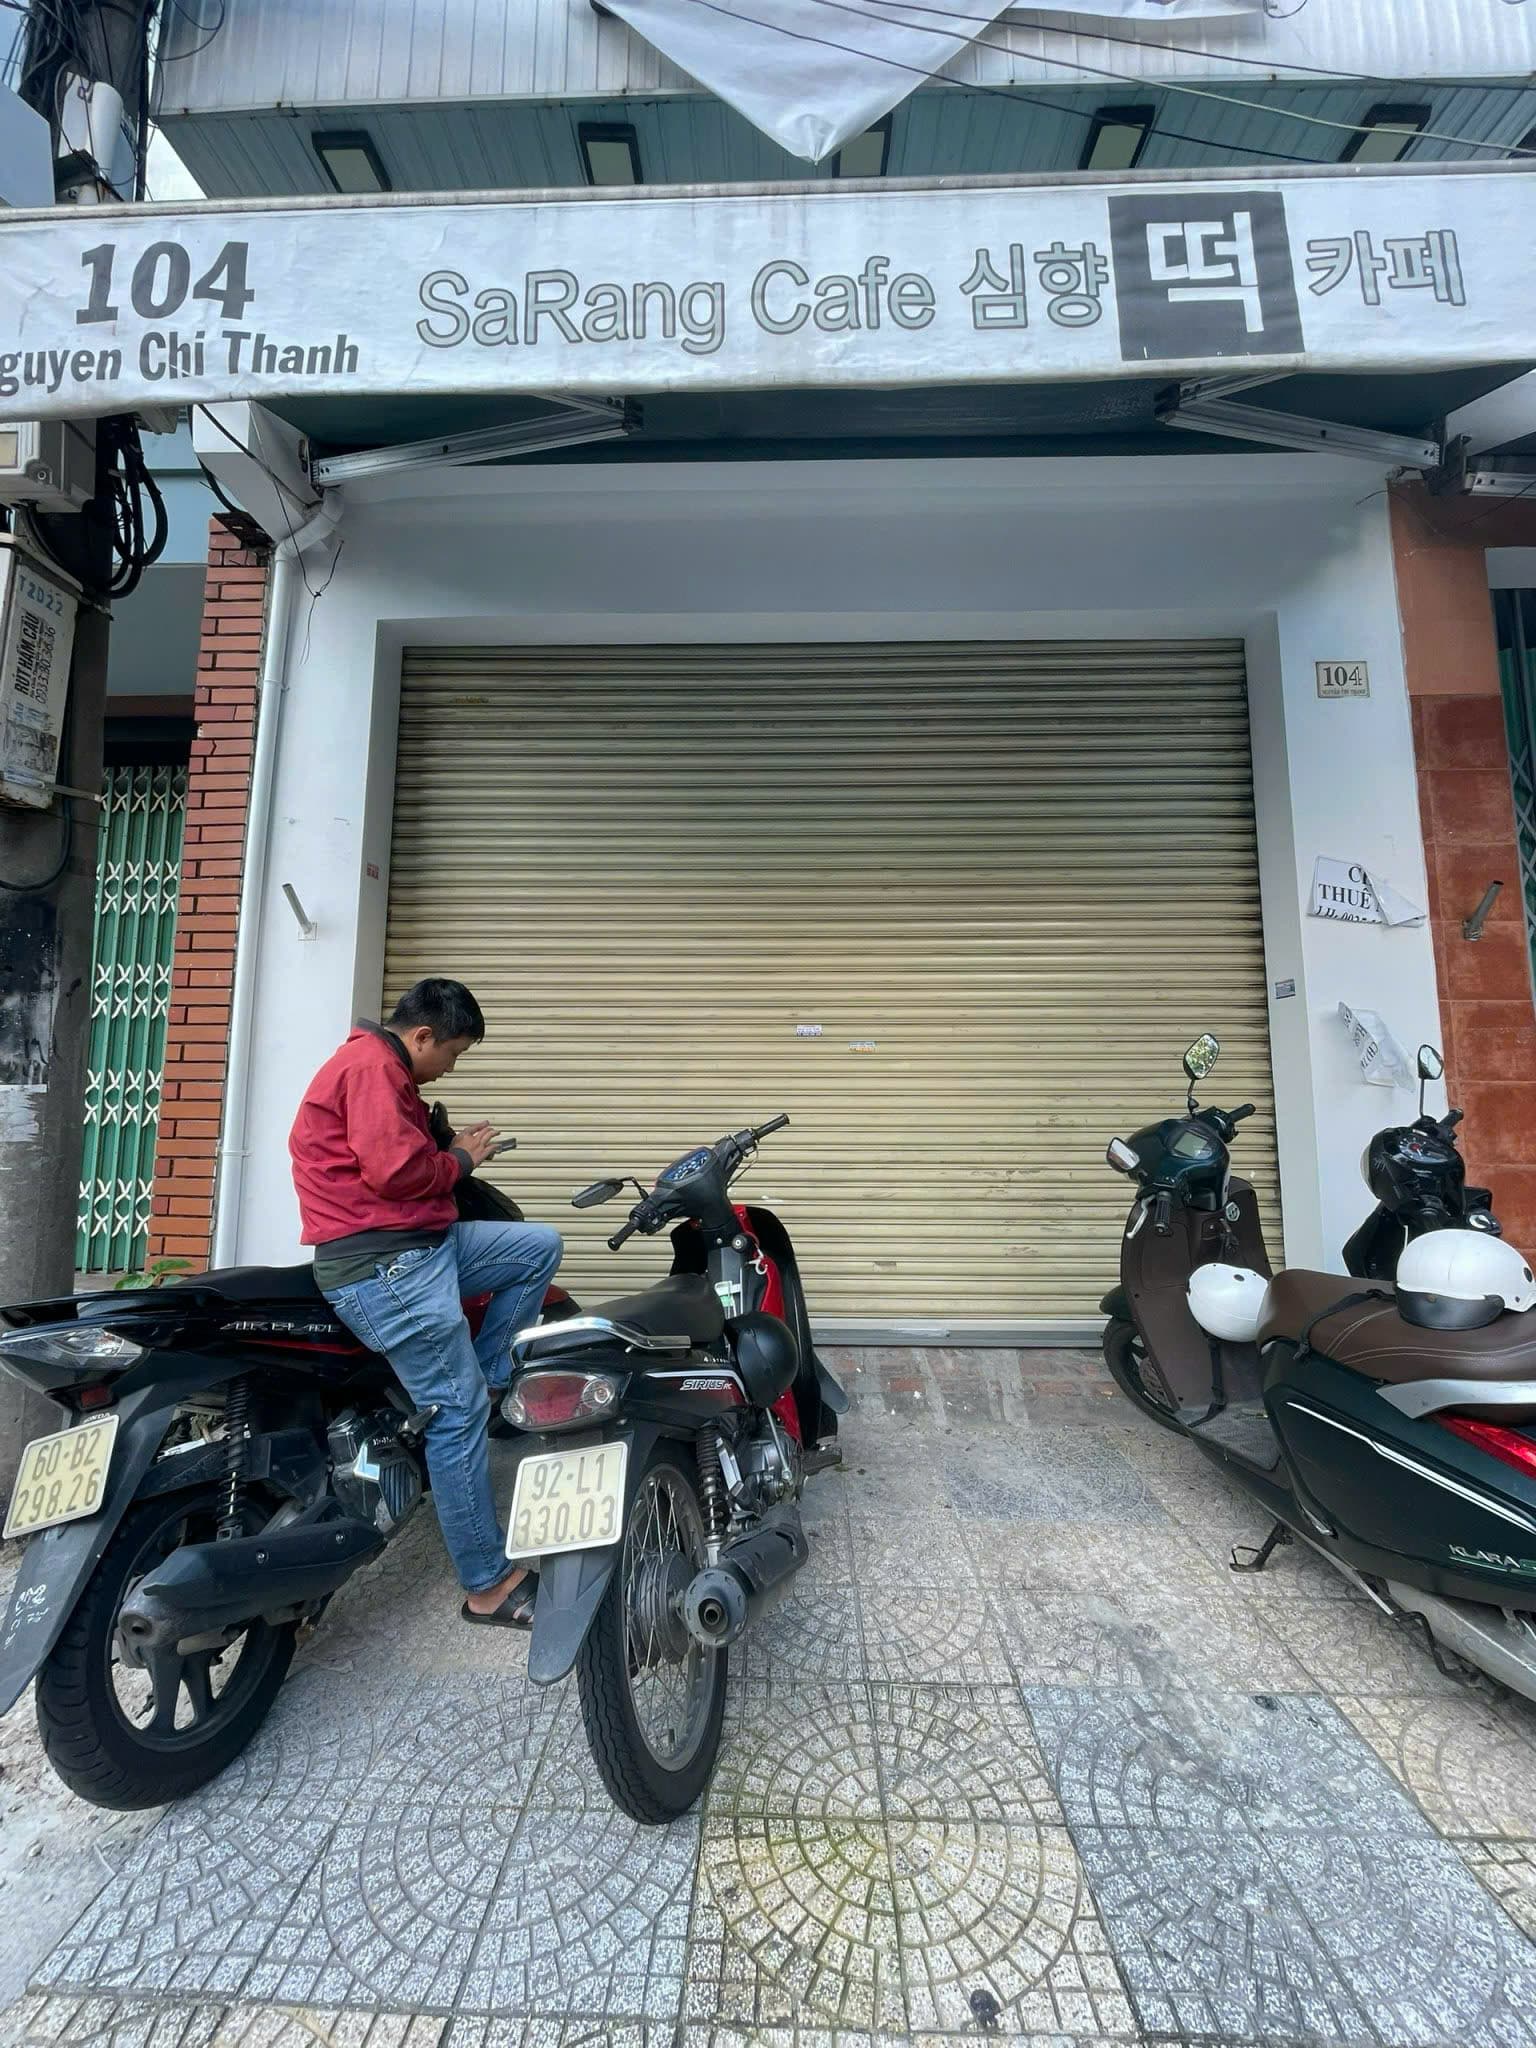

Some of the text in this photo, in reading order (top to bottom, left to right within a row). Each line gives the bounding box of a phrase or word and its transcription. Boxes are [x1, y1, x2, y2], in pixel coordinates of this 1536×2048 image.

[76, 241, 255, 324] 104
[959, 212, 1466, 333] 심향 떡 카페
[416, 256, 936, 355] SaRang Cafe
[139, 331, 205, 381] Chi
[222, 330, 359, 376] Thanh
[1323, 666, 1363, 687] 104
[1318, 883, 1372, 910] THUÊ
[680, 1378, 725, 1391] SIRIUS
[12, 1468, 101, 1529] 298.26
[516, 1496, 615, 1548] 330.03
[1449, 1544, 1521, 1569] KLARA
